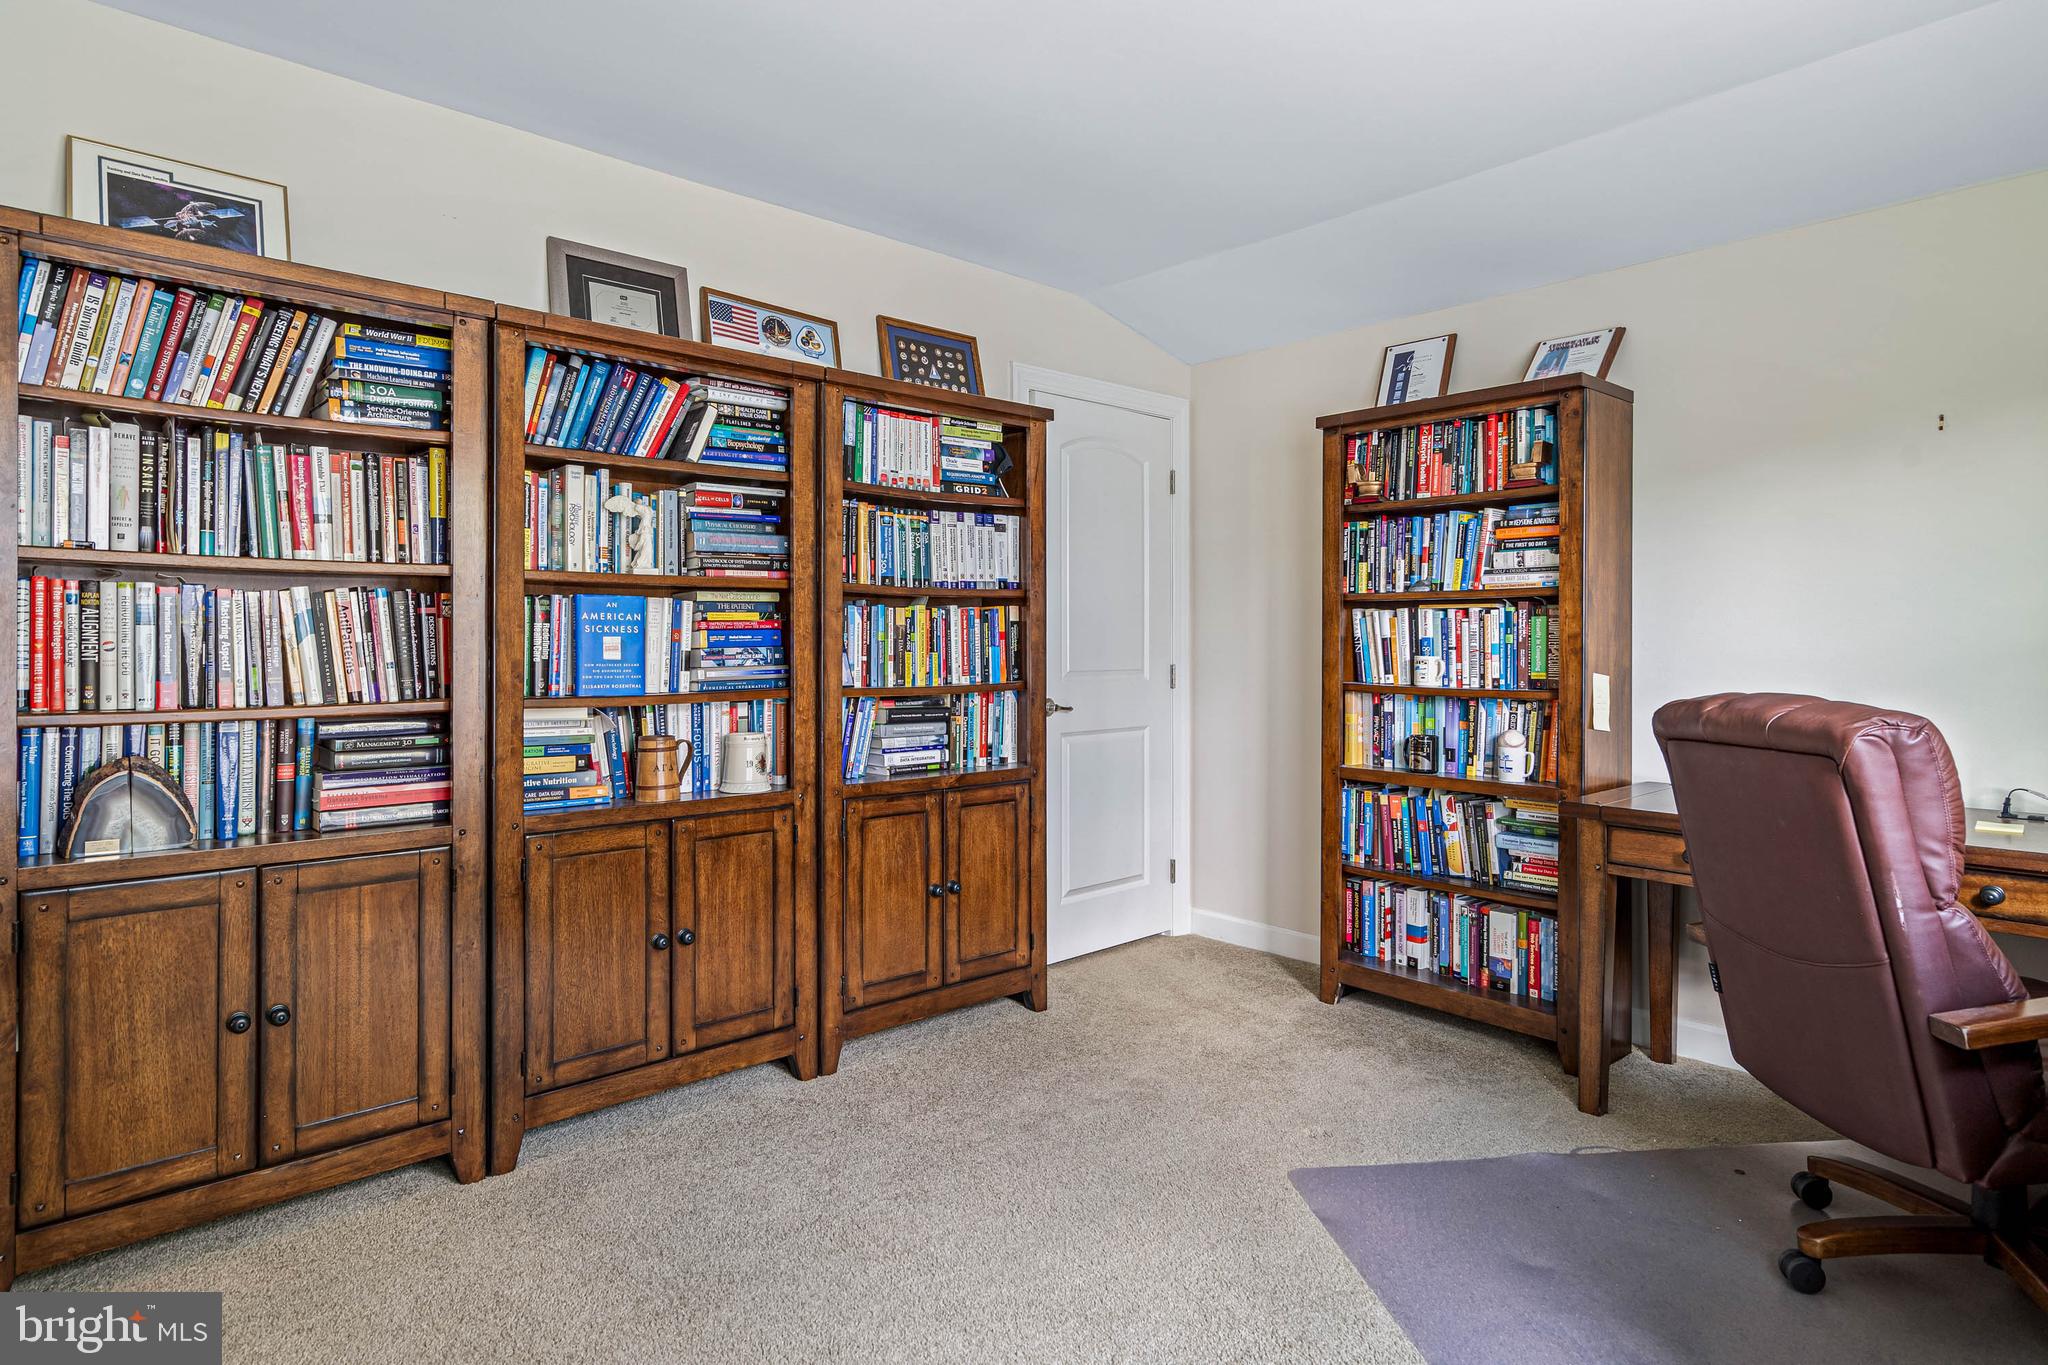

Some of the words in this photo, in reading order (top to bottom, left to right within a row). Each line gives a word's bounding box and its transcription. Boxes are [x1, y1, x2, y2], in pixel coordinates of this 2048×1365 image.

[87, 294, 101, 306] IS
[118, 295, 131, 319] Software
[79, 303, 99, 337] Survival
[148, 301, 163, 324] Public
[110, 318, 125, 346] Architect
[139, 324, 157, 352] Health
[167, 310, 185, 349] EXECUTING
[268, 318, 288, 348] SEEING
[365, 328, 389, 339] World
[390, 332, 407, 341] War
[407, 334, 413, 343] II
[70, 335, 88, 368] Guide
[229, 322, 250, 361] MANAGING
[154, 350, 173, 385] STRATEGY
[220, 363, 235, 383] RISK
[256, 348, 275, 379] WHAT'S
[349, 361, 362, 369] THE
[364, 364, 420, 377] KNOWING-DOING
[421, 370, 438, 379] GAP
[248, 376, 266, 401] NEXT
[367, 372, 388, 381] Machine
[389, 375, 412, 386] Learning
[419, 380, 435, 388] ACTION
[369, 385, 396, 396] SOA
[366, 404, 429, 418] Service-Oriented
[369, 395, 396, 405] Design
[397, 398, 438, 409] Patterns
[366, 411, 412, 421] Architecture
[113, 432, 136, 441] BEHAVE
[726, 440, 765, 452] Biopsychology
[1420, 435, 1428, 462] Lifecycle
[141, 453, 154, 493] INSANE
[160, 455, 168, 478] Logic
[955, 485, 982, 494] GRID
[728, 522, 756, 530] CHEMISTRY
[53, 586, 63, 599] The
[53, 602, 63, 619] New
[164, 596, 173, 633] Information
[220, 600, 231, 640] Mastering
[581, 612, 641, 621] AMERICAN
[51, 619, 63, 660] Strategists
[81, 608, 99, 662] ALIGNMENT
[340, 605, 355, 675] AntiPatterns
[533, 622, 542, 645] Health
[584, 624, 639, 634] SICKNESS
[319, 622, 328, 663] CONTEXTUAL
[429, 637, 437, 666] PATTERNS
[542, 622, 550, 660] Redefining
[163, 633, 173, 675] Development
[219, 641, 231, 673] AspectJ
[532, 645, 541, 662] Care
[150, 738, 160, 746] IT
[693, 728, 702, 764] FOCUS
[28, 745, 37, 765] Value
[61, 745, 76, 787] Connecting
[242, 765, 254, 813] ENTERPRISE
[543, 777, 577, 786] Nutrition
[63, 786, 75, 801] The
[62, 801, 73, 820] Dots
